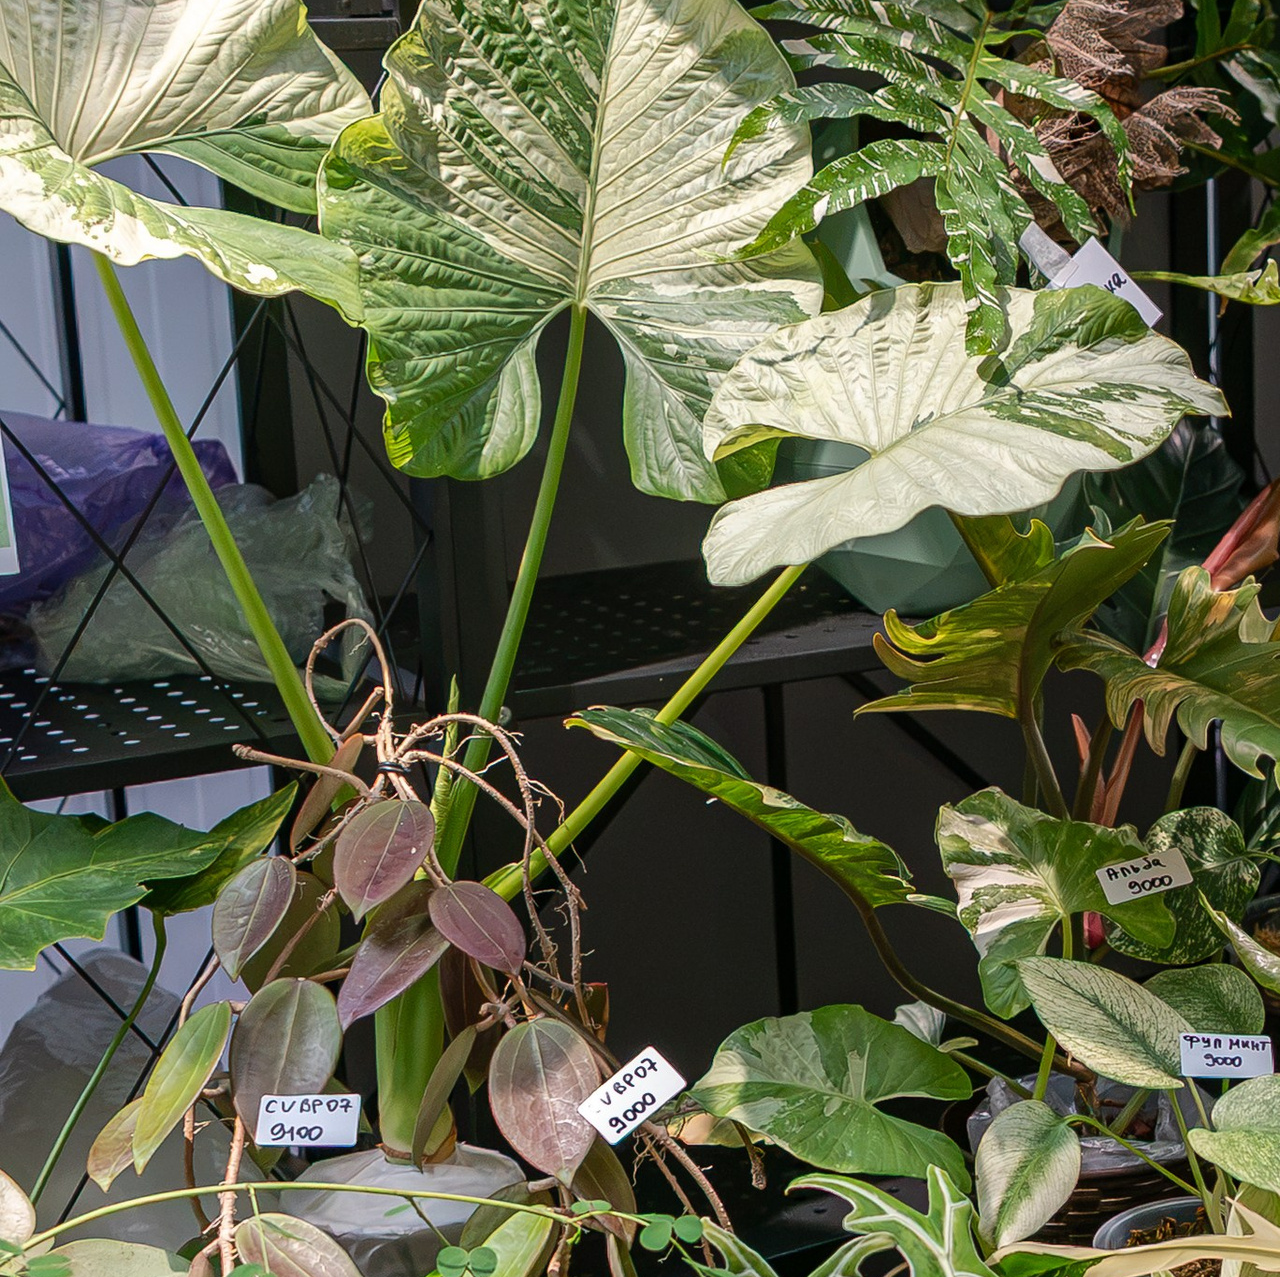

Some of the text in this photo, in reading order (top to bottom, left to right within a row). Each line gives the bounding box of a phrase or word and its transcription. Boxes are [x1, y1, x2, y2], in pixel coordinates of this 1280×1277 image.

[1128, 874, 1173, 895] 9000
[1203, 1053, 1243, 1068] 9000
[608, 1092, 656, 1134] 9000
[270, 1122, 323, 1142] 9100
